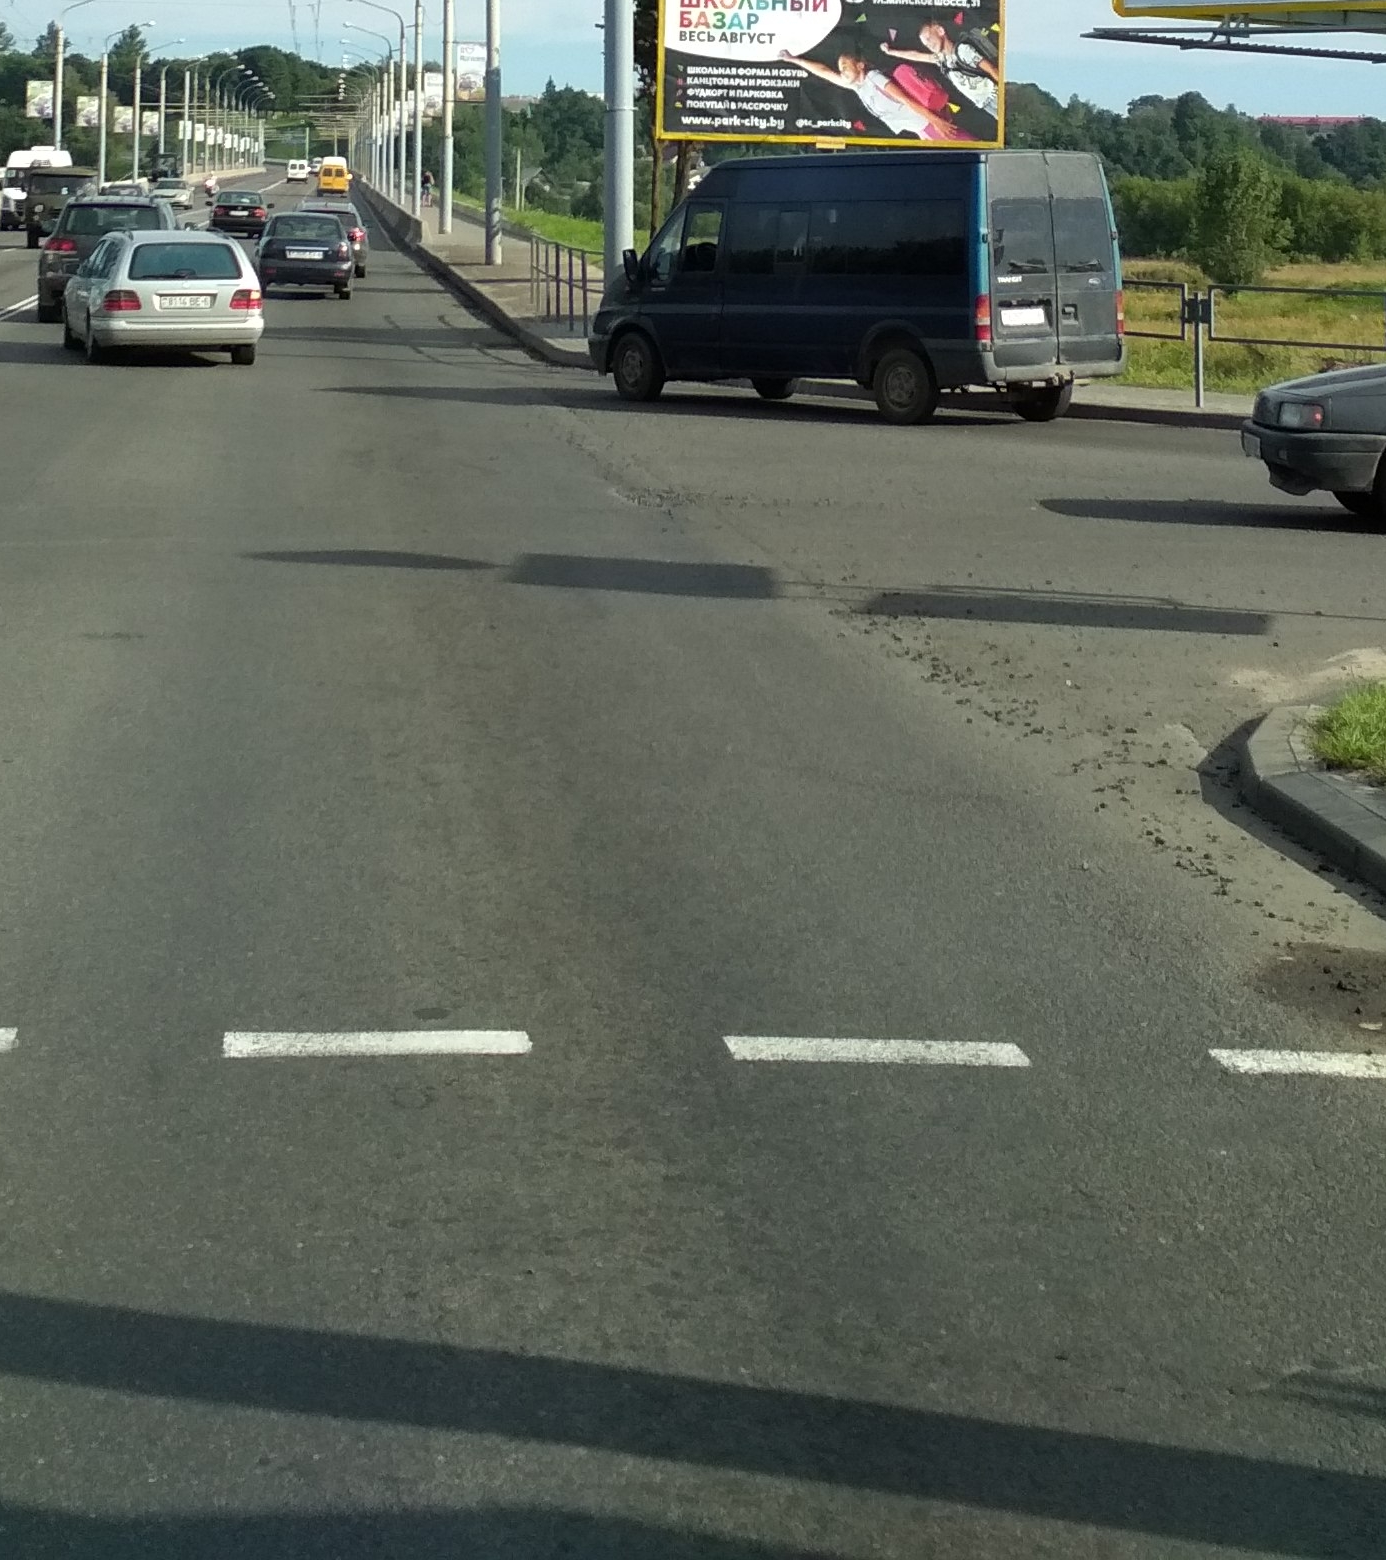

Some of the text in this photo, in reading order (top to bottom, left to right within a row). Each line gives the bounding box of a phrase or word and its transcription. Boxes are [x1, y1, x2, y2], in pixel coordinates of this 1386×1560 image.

[679, 10, 760, 30] БАЗАР
[679, 30, 776, 44] ВЕСЬ АВГУСТ
[686, 66, 737, 76] ШКОЛЬНАЯ
[737, 67, 771, 77] ФОРМА
[780, 69, 808, 78] ОБУВЬ
[686, 77, 748, 86] КАНЦТОВАРЫ
[756, 79, 801, 88] РЮКЗАКИ
[686, 88, 728, 98] ФУДКОРТ
[737, 89, 784, 99] ПАРКОВКА
[686, 100, 730, 110] ПОКУПАЙ
[737, 102, 789, 111] РАССРОЧКУ
[681, 115, 785, 130] www.park-city.by
